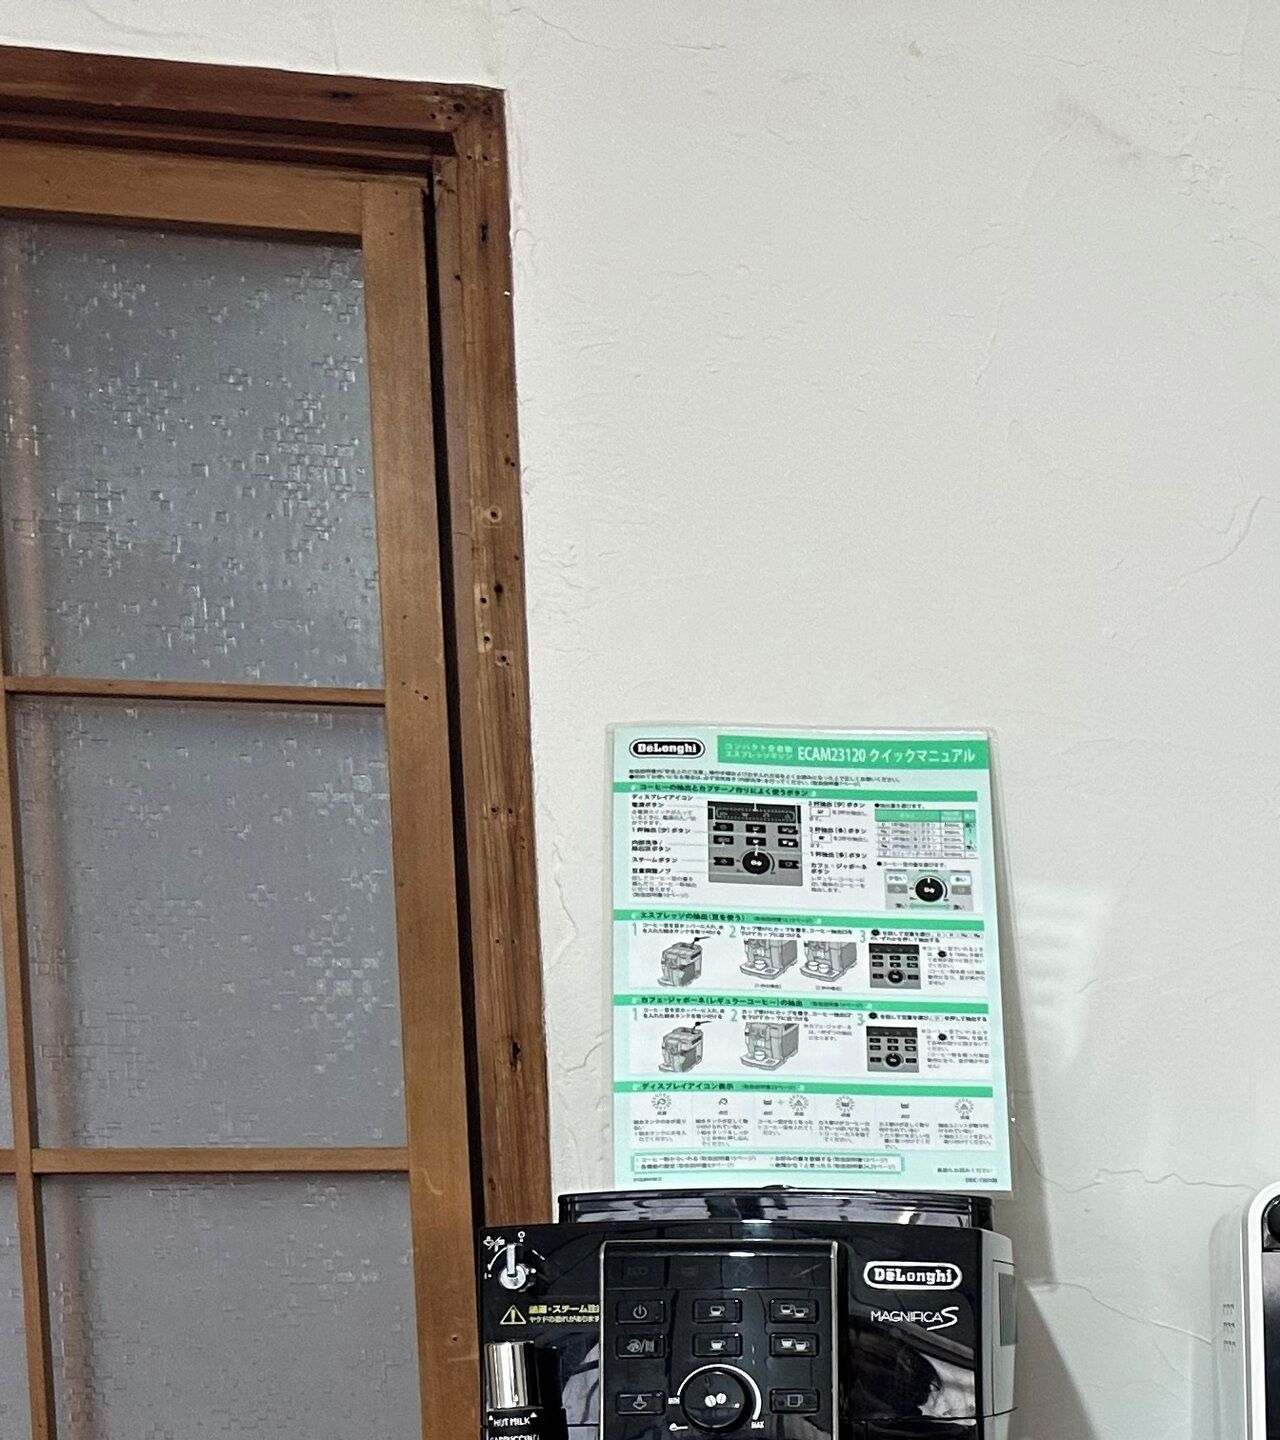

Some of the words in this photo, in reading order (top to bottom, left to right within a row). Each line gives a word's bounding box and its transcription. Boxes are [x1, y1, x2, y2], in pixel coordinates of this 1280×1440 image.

[797, 746, 866, 763] ECAM23120
[869, 748, 976, 763] クイックマニュアル
[926, 1306, 960, 1331] S
[493, 1418, 509, 1427] HOT
[509, 1416, 531, 1427] MILK
